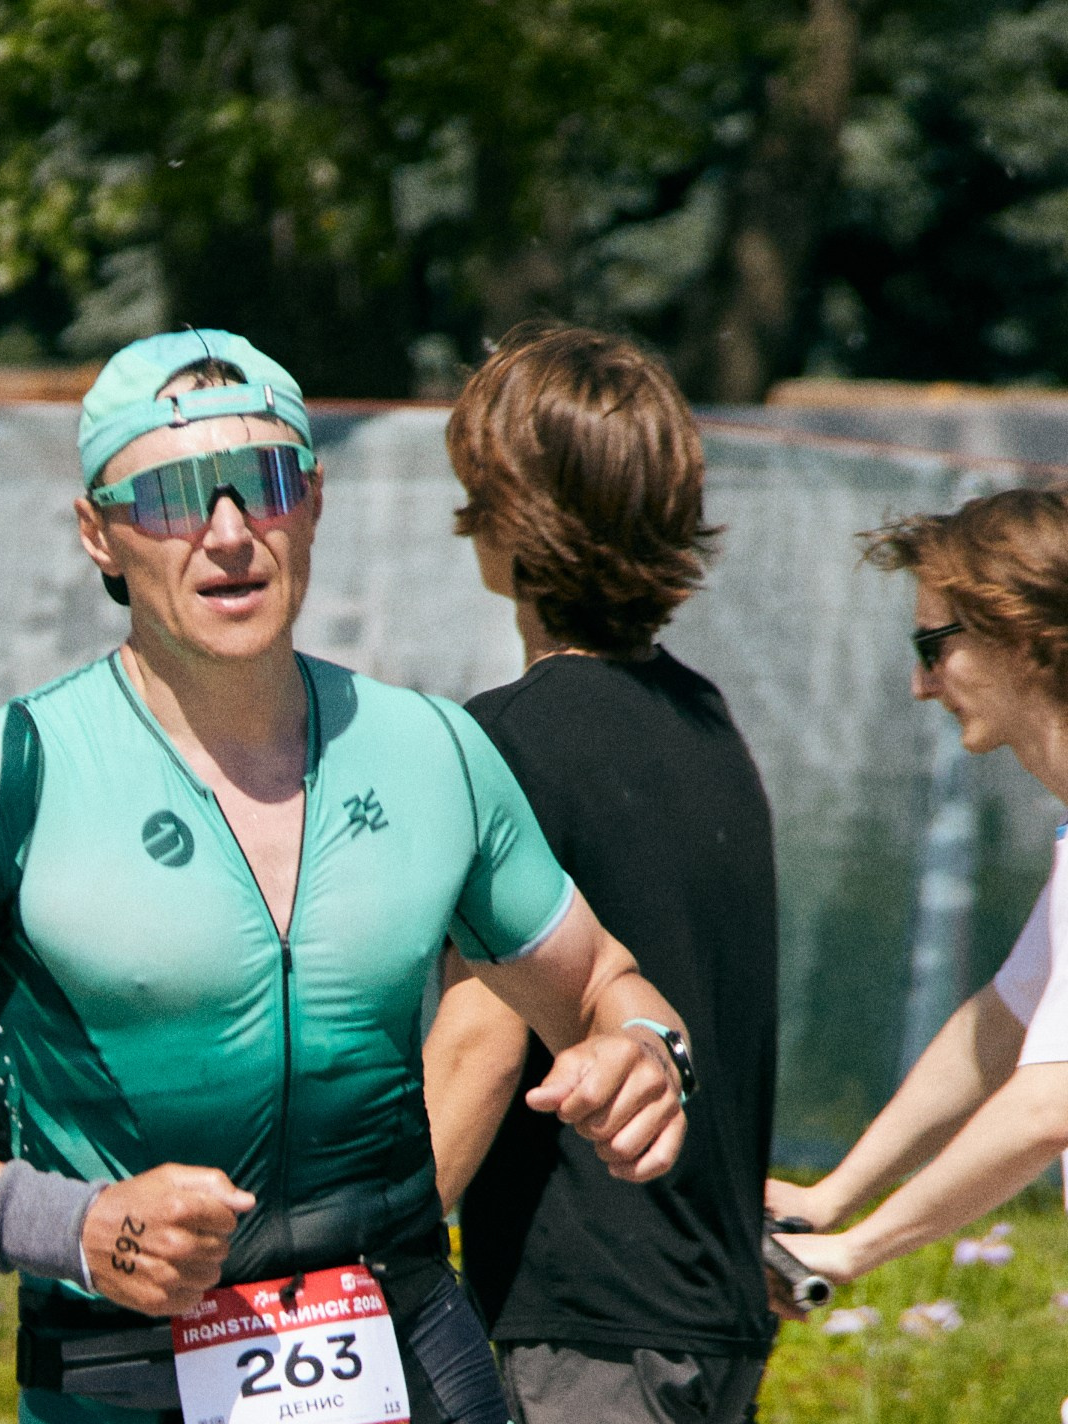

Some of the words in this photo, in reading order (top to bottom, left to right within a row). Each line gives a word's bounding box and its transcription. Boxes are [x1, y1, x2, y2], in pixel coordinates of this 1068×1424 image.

[111, 1215, 146, 1276] 263
[182, 1313, 277, 1344] IRONSTAR
[278, 1298, 352, 1327] МИНСК
[236, 1331, 363, 1399] 263
[278, 1394, 346, 1421] ДЕНИС
